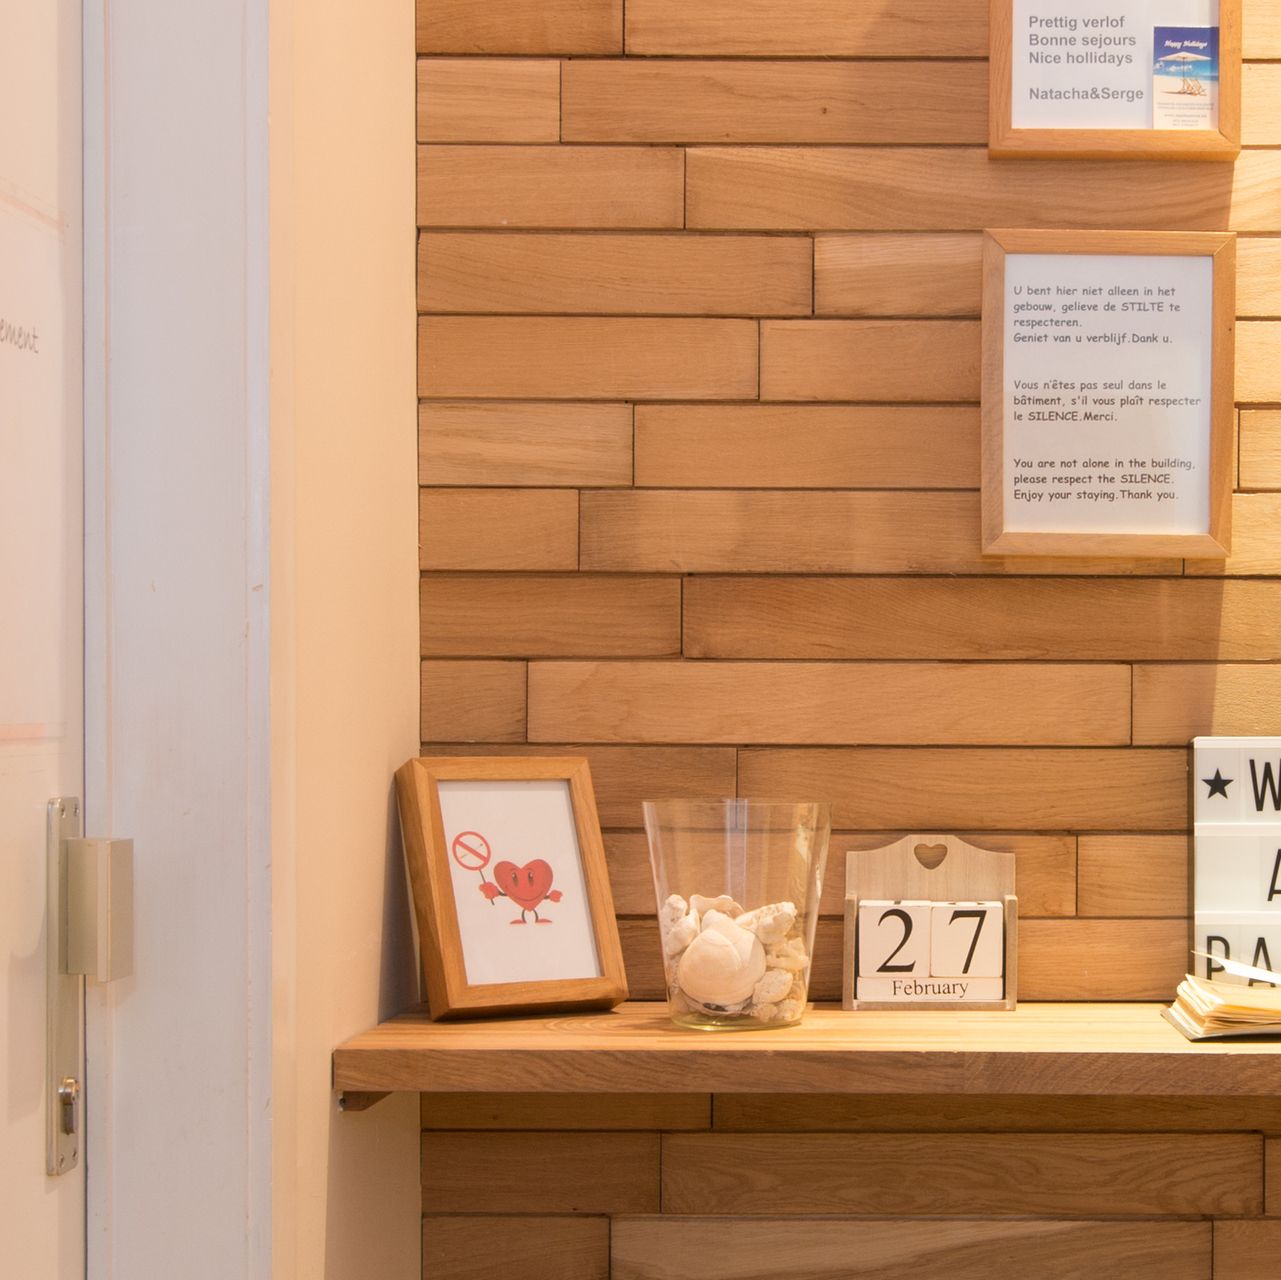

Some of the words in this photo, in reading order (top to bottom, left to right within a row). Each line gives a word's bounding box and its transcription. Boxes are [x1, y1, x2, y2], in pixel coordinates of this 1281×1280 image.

[1029, 16, 1077, 30] Prettig
[1082, 16, 1125, 28] verlof
[1029, 34, 1077, 46] Bonne
[1082, 34, 1136, 48] sejours
[1029, 51, 1061, 64] Nice
[1066, 52, 1133, 67] hollidays
[1029, 87, 1144, 102] Natacha&Serge
[1014, 286, 1022, 296] U
[1026, 285, 1051, 296] bent
[1056, 285, 1078, 296] hier
[1082, 286, 1104, 296] niet
[1107, 286, 1139, 296] alleen
[1143, 286, 1153, 296] in
[1158, 286, 1176, 296] het
[1061, 300, 1098, 314] gelieve
[1103, 301, 1116, 312] de
[1121, 301, 1164, 312] STILTE
[1169, 303, 1180, 312] te
[1013, 332, 1049, 343] Geniet
[1053, 335, 1071, 343] van
[1075, 335, 1082, 343] u
[1014, 380, 1039, 390] Vous
[1043, 379, 1076, 390] n'êtes
[1080, 382, 1098, 393] pas
[1102, 379, 1124, 390] seul
[1128, 380, 1153, 390] dans
[1157, 380, 1166, 390] le
[1071, 395, 1088, 406] s'il
[1092, 398, 1116, 406] vous
[1120, 395, 1144, 408] plaît
[1148, 397, 1201, 408] respecter
[1014, 411, 1023, 421] le
[1013, 458, 1033, 468] You
[1037, 460, 1056, 468] are
[1060, 459, 1078, 468] not
[1082, 458, 1110, 468] alone
[1114, 458, 1124, 468] in
[1128, 458, 1147, 468] the
[1014, 474, 1047, 486] please
[1052, 475, 1093, 486] respect
[1097, 474, 1116, 484] the
[1014, 488, 1044, 502] Enjoy
[1048, 492, 1072, 502] your
[892, 980, 969, 998] February
